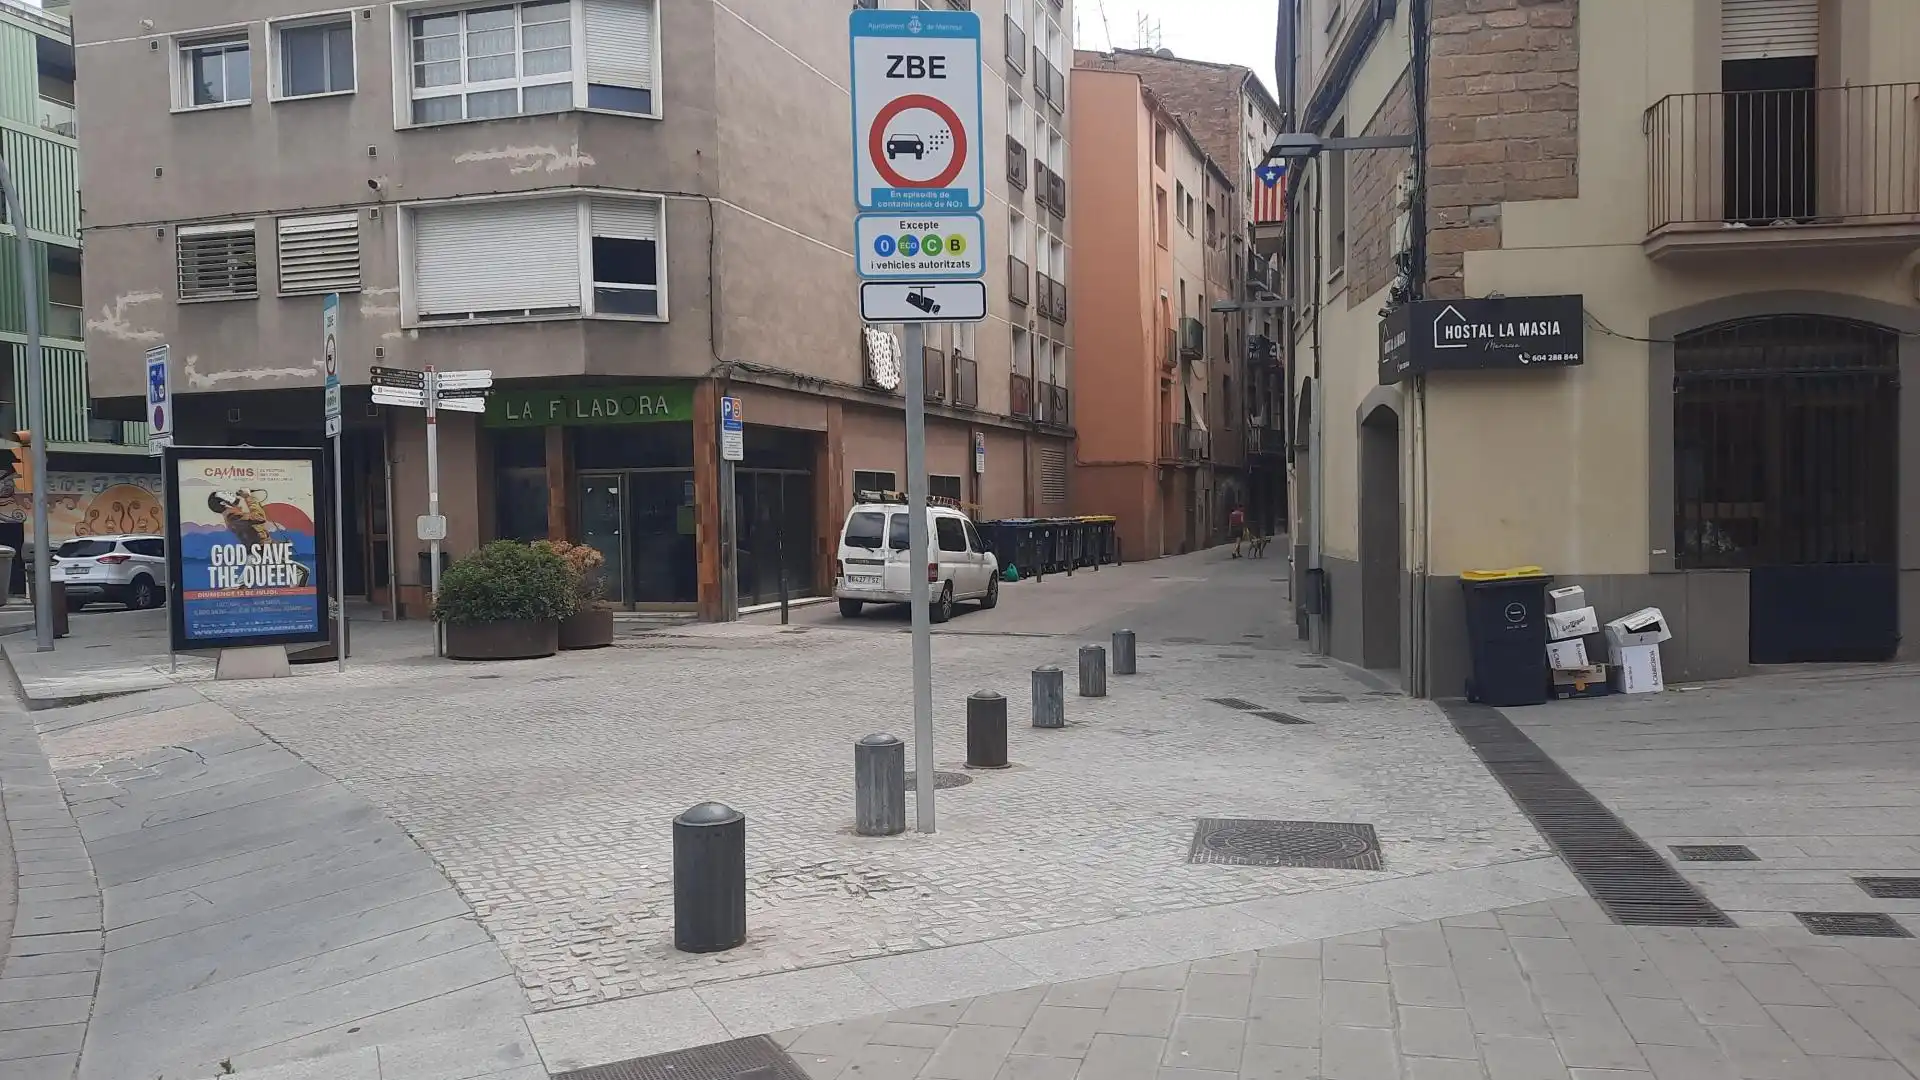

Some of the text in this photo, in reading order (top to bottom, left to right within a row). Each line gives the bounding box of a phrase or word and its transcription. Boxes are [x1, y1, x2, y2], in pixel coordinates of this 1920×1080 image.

[868, 22, 905, 31] Ajuntament
[935, 23, 962, 31] Manresa
[886, 55, 947, 79] ZBE
[890, 190, 901, 198] En
[939, 190, 949, 198] de
[877, 200, 932, 208] contaminació
[934, 200, 944, 208] de
[900, 220, 939, 231] Excepte
[926, 239, 937, 251] C
[950, 239, 961, 251] B
[877, 260, 915, 269] vehicles
[918, 260, 971, 269] autoritzats
[1445, 321, 1561, 340] HOSTAL LA MASIA
[1532, 352, 1578, 362] 604 288 844
[506, 401, 532, 420] LA
[724, 400, 732, 417] P
[204, 465, 254, 479] CAMINS
[211, 542, 293, 566] GOD SAVE
[208, 564, 298, 588] THE QUEEN
